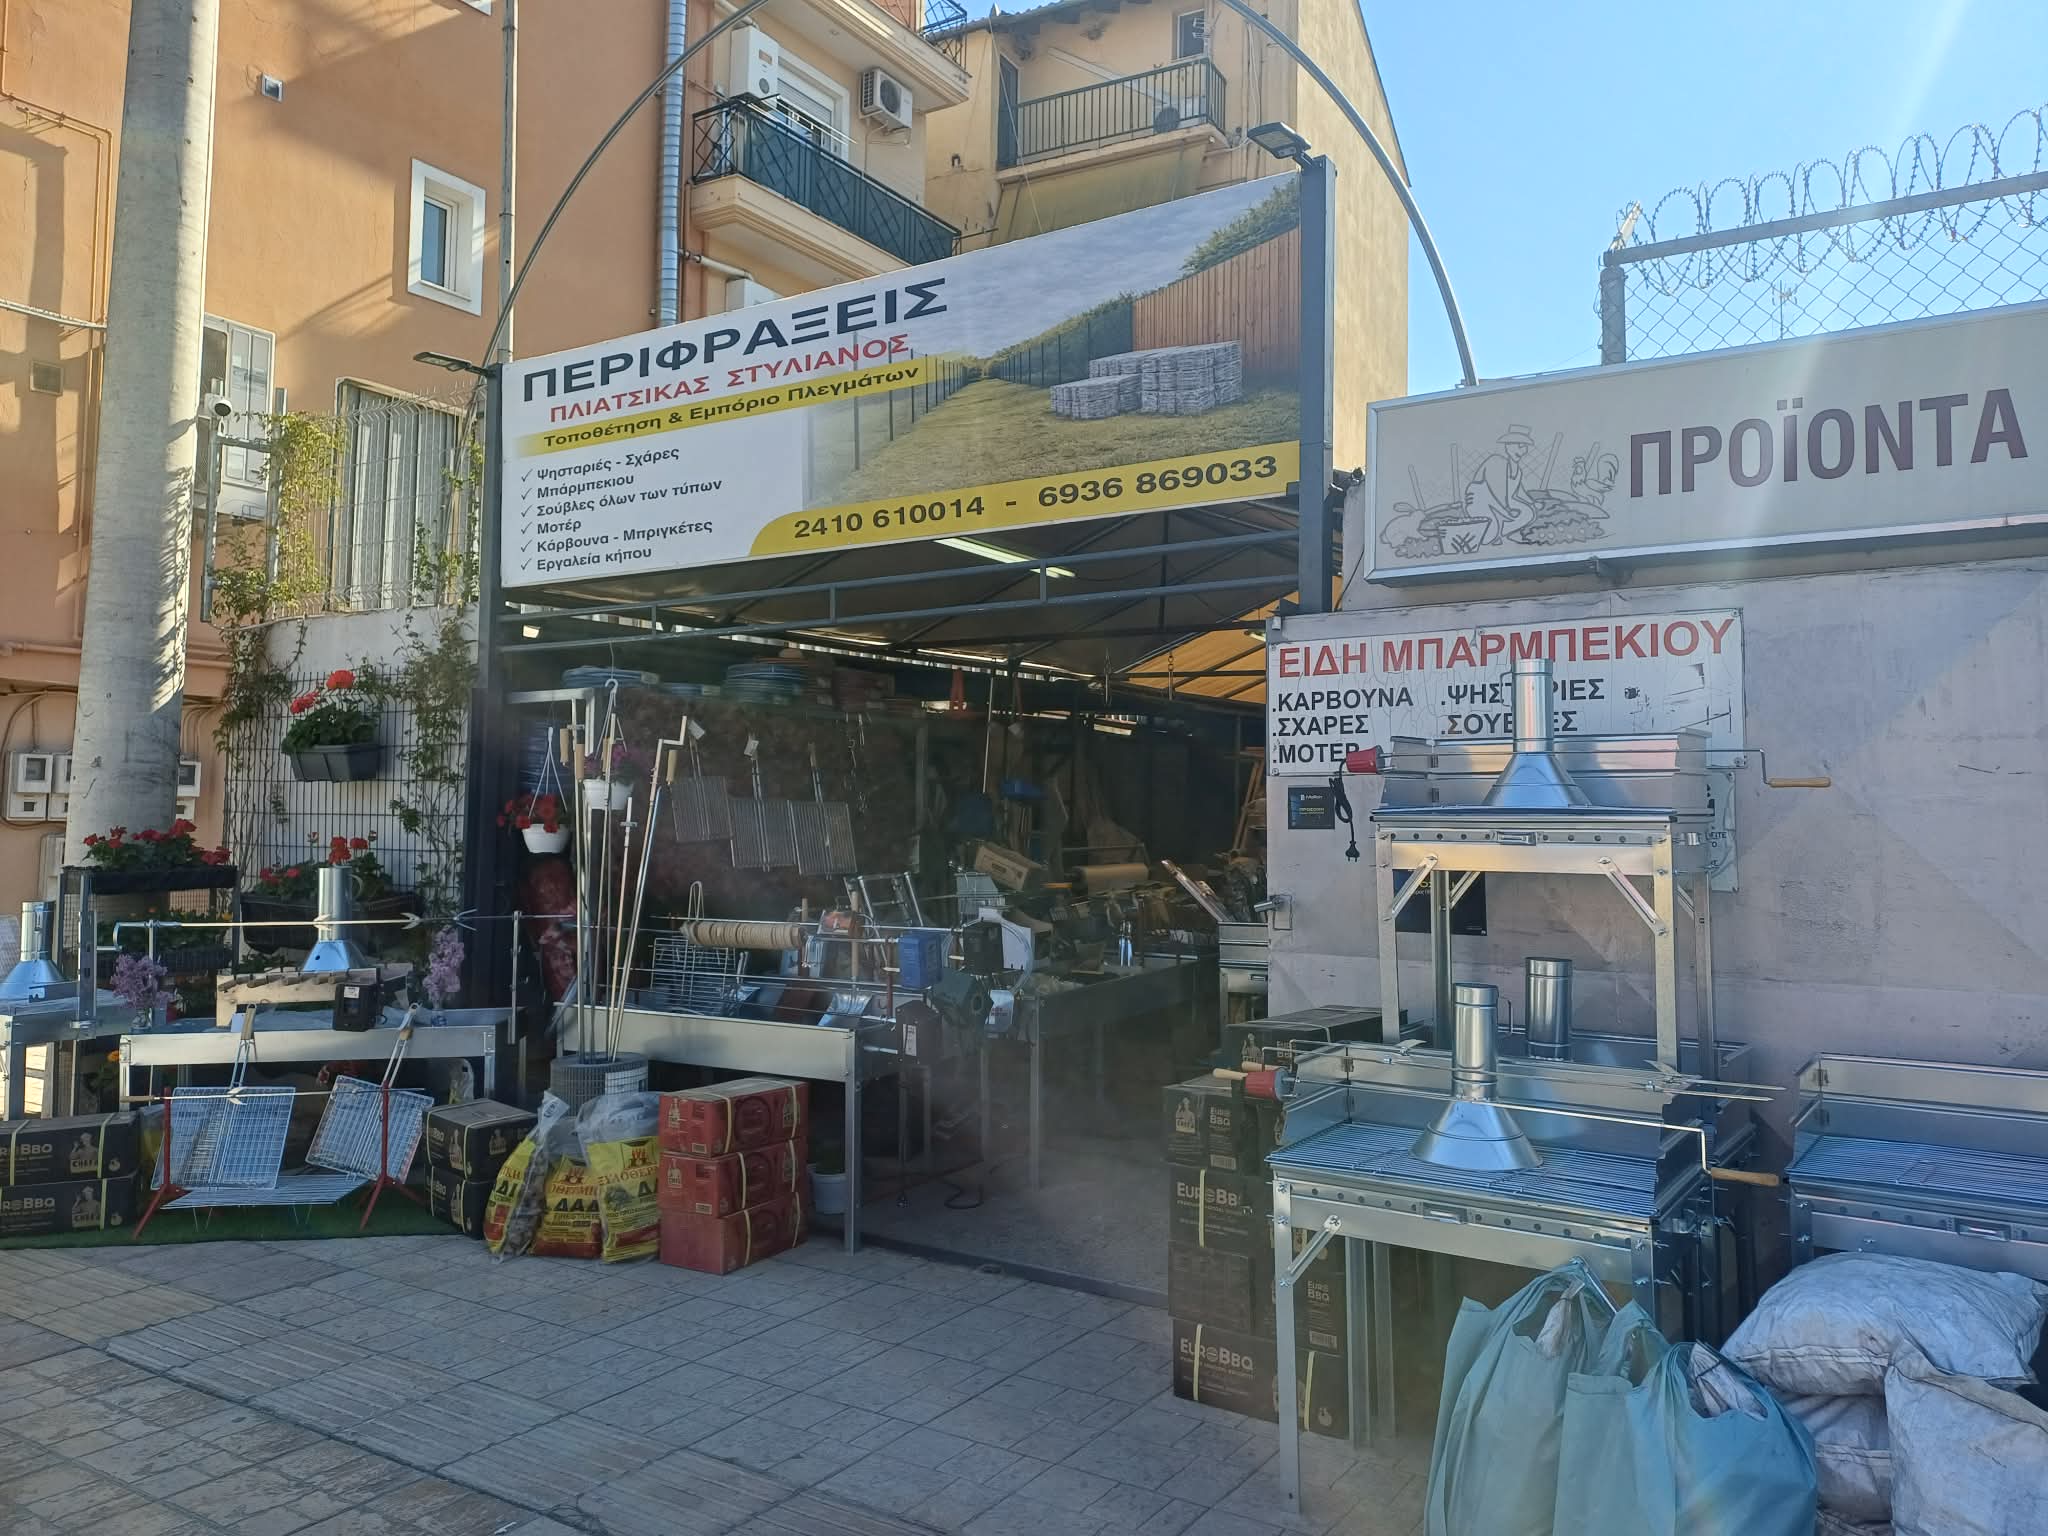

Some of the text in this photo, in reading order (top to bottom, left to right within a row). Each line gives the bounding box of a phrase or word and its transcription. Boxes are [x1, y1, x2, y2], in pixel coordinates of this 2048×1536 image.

[523, 277, 948, 402] ΠΕΡΙΦΡΑΞΕΙΣ
[549, 334, 909, 423] ΠΛΙΑΤΣΙΚΑΣ ΣΤΥΛΙΑΝΟΣ
[544, 367, 919, 448] Τοποθέτηση & Εμπόριο Πλεγμάτων
[537, 458, 612, 481] Ψησταριές
[625, 448, 680, 468] Σχάρες
[1630, 388, 2029, 499] ΠΡΟΪΟΝΤΑ
[536, 480, 722, 518] Σούβλες όλων των τύπων
[537, 475, 634, 499] Μπάρμπεκιου
[794, 513, 863, 539] 2410
[872, 495, 985, 529] 610014
[1038, 477, 1124, 508] 6936
[1135, 455, 1278, 494] 869033
[536, 534, 609, 553] Κάρβουνα
[623, 520, 713, 542] Μπριγκέτες
[537, 519, 582, 535] Μοτέρ
[536, 548, 652, 572] Εργαλεία κήπου
[1279, 618, 1735, 678] ΕΙΔΗ ΜΠΑΡΜΠΕΚΙΟΥ
